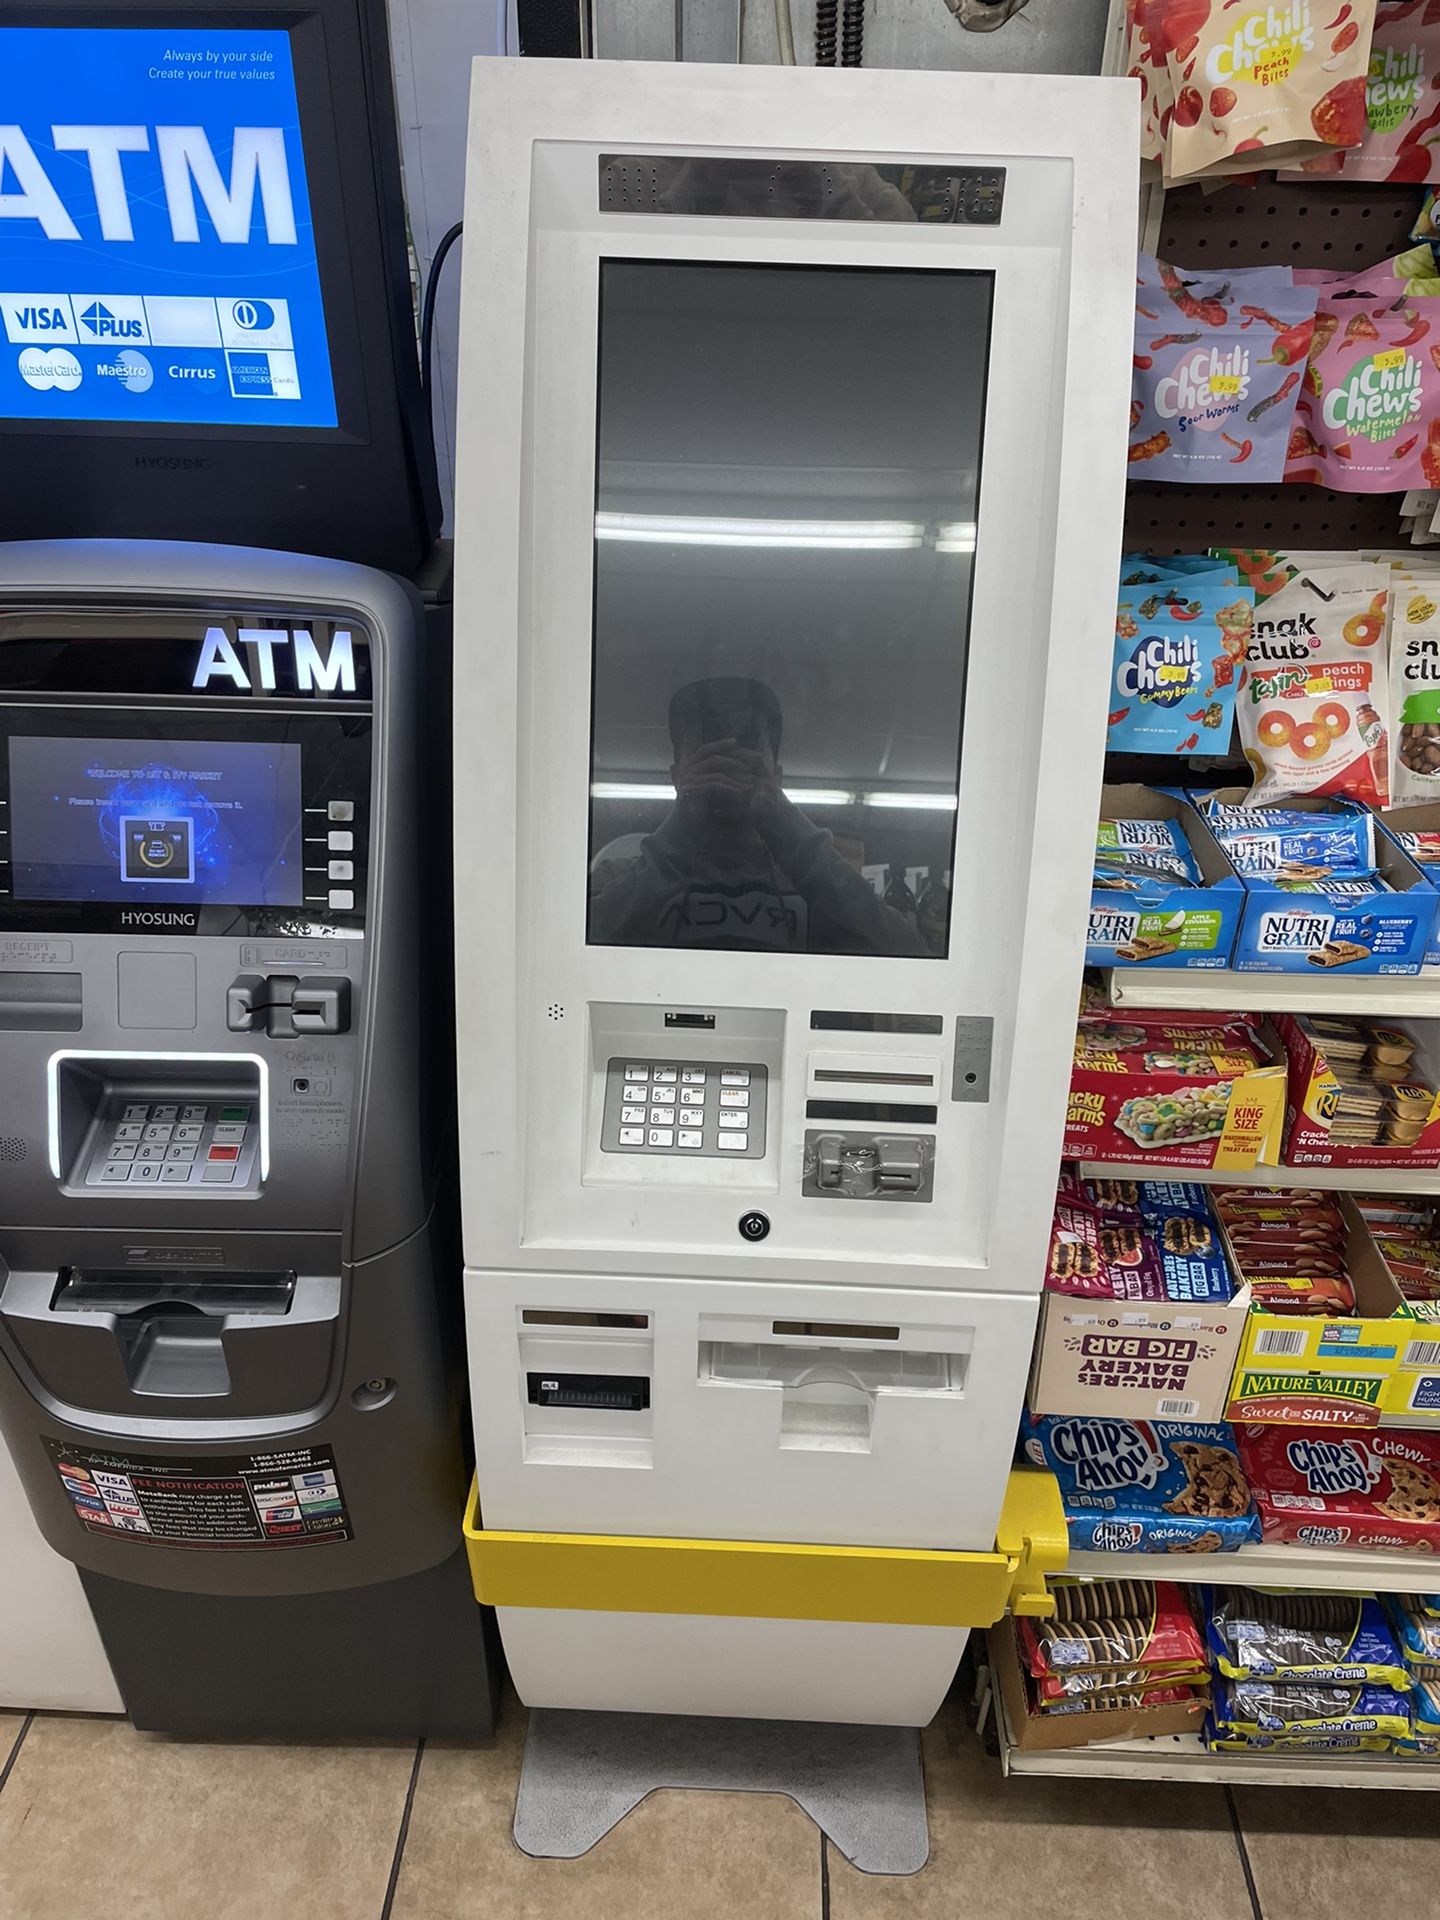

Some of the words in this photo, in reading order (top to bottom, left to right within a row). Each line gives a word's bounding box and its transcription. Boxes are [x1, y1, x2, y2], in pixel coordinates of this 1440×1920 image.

[164, 50, 203, 63] Always
[206, 50, 220, 63] by
[222, 52, 247, 63] your
[250, 51, 273, 62] side
[149, 67, 184, 79] Create
[187, 69, 212, 81] your
[214, 69, 237, 79] true
[240, 69, 275, 80] values
[1253, 57, 1289, 80] Peach
[1262, 69, 1289, 87] Bites
[15, 307, 68, 330] VISA
[99, 320, 144, 338] PLUS
[97, 363, 147, 378] Maestro
[231, 366, 269, 376] AMERICAN
[1189, 345, 1250, 384] Chili
[168, 365, 217, 380] Cirrus
[1360, 355, 1423, 396] Chili
[240, 375, 273, 384] EXPRESS
[1323, 377, 1424, 430] Chews
[1178, 413, 1204, 432] Sour
[1206, 403, 1240, 419] Worms
[1346, 410, 1422, 437] Watermelon
[1370, 428, 1396, 444] Bites
[1147, 635, 1199, 667] Chili
[192, 627, 356, 691] ATM
[1322, 664, 1365, 678] peach
[1140, 689, 1174, 704] Gummy
[1175, 686, 1198, 697] Bears
[1123, 833, 1173, 846] NUTRI
[1283, 841, 1302, 850] REAL
[1284, 847, 1303, 856] FRUIT
[1234, 855, 1276, 871] RAIN
[121, 912, 195, 927] HYOSUNG
[1089, 914, 1135, 928] UTRI
[1266, 917, 1330, 933] NUTRI
[1336, 922, 1356, 930] REAL
[1087, 928, 1135, 941] RAIN
[1335, 928, 1356, 936] FRUIT
[1263, 932, 1327, 947] GRAIN
[5, 942, 50, 951] RECEIPT
[274, 948, 306, 958] CARD
[628, 1070, 633, 1079] 1
[655, 1071, 663, 1080] 2
[684, 1072, 692, 1081] 3
[625, 1090, 632, 1099] 4
[654, 1092, 662, 1101] 5
[683, 1093, 691, 1102] 6
[1069, 1092, 1106, 1112] ucky
[126, 1109, 133, 1118] 1
[155, 1109, 163, 1118] 2
[184, 1110, 193, 1119] 3
[624, 1112, 631, 1121] 7
[652, 1113, 660, 1122] 8
[682, 1114, 689, 1123] 9
[1067, 1109, 1107, 1127] arms
[1234, 1107, 1264, 1119] KING
[1234, 1118, 1259, 1130] SIZE
[119, 1128, 127, 1137] 4
[149, 1128, 157, 1138] 5
[179, 1128, 187, 1138] 6
[651, 1133, 658, 1142] 0
[114, 1147, 122, 1157] 7
[142, 1148, 151, 1158] 8
[173, 1149, 181, 1158] 9
[1222, 1146, 1241, 1154] TREAT
[1242, 1146, 1257, 1154] BARS
[142, 1166, 151, 1177] 0
[1254, 1190, 1283, 1199] Almond
[1261, 1221, 1291, 1229] Almond
[1175, 1255, 1194, 1301] BAKERY
[1193, 1264, 1206, 1281] BAR
[1210, 1267, 1221, 1293] Blueberry
[1196, 1281, 1208, 1296] FIG
[1269, 1297, 1300, 1305] Almond
[1086, 1337, 1142, 1356] BAR
[1147, 1339, 1192, 1360] FIG
[1079, 1359, 1191, 1378] BAKERY
[1245, 1374, 1313, 1395] NATURE
[1315, 1378, 1378, 1400] VALLEY
[1241, 1405, 1291, 1420] Sweet
[1301, 1409, 1355, 1421] SALTY
[1157, 1423, 1225, 1441] ORIGINAL
[1053, 1421, 1141, 1461] Chips
[1290, 1440, 1357, 1471] Chips
[238, 1459, 330, 1475] www.atmofamerica.com
[96, 1475, 128, 1486] VISA
[156, 1481, 245, 1490] NOTIFICATION
[254, 1481, 289, 1491] pulse
[112, 1494, 136, 1504] PLUS
[138, 1490, 178, 1498] MetaBank
[109, 1503, 139, 1513] NYCE
[80, 1510, 112, 1525] STAR
[1094, 1524, 1133, 1543] Chips
[1149, 1529, 1198, 1541] ORIGINAL
[1299, 1527, 1341, 1539] Chips
[1333, 1666, 1367, 1680] Creme
[1342, 1719, 1377, 1732] Creme
